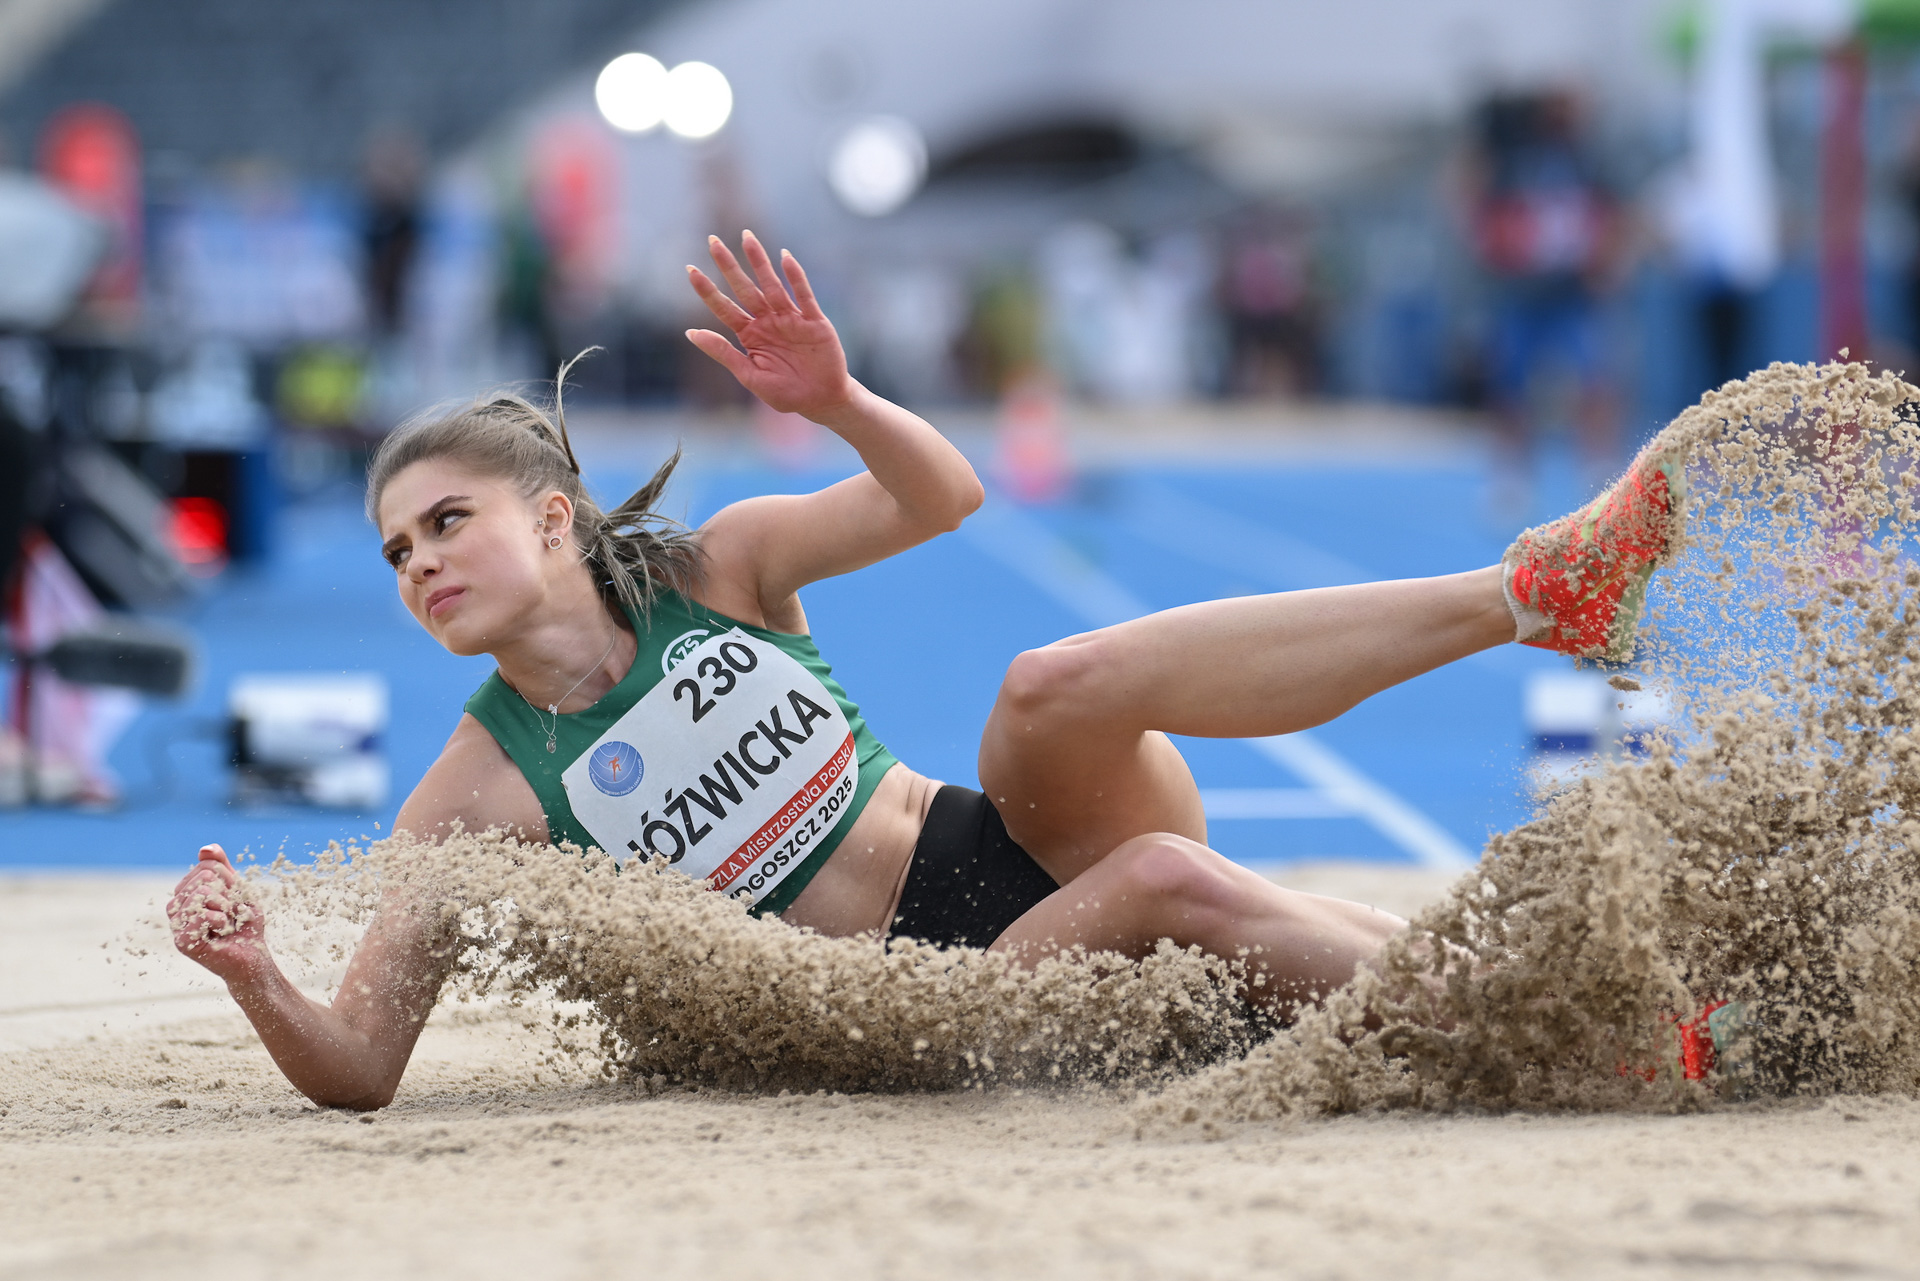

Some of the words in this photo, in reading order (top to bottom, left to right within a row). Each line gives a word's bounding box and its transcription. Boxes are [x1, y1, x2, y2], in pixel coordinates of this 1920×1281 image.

[670, 638, 700, 668] AZS
[673, 641, 758, 723] 230
[706, 861, 743, 890] ZLA
[739, 785, 822, 864] Mistrzostwa
[819, 743, 852, 787] Polski
[818, 776, 852, 823] 2025
